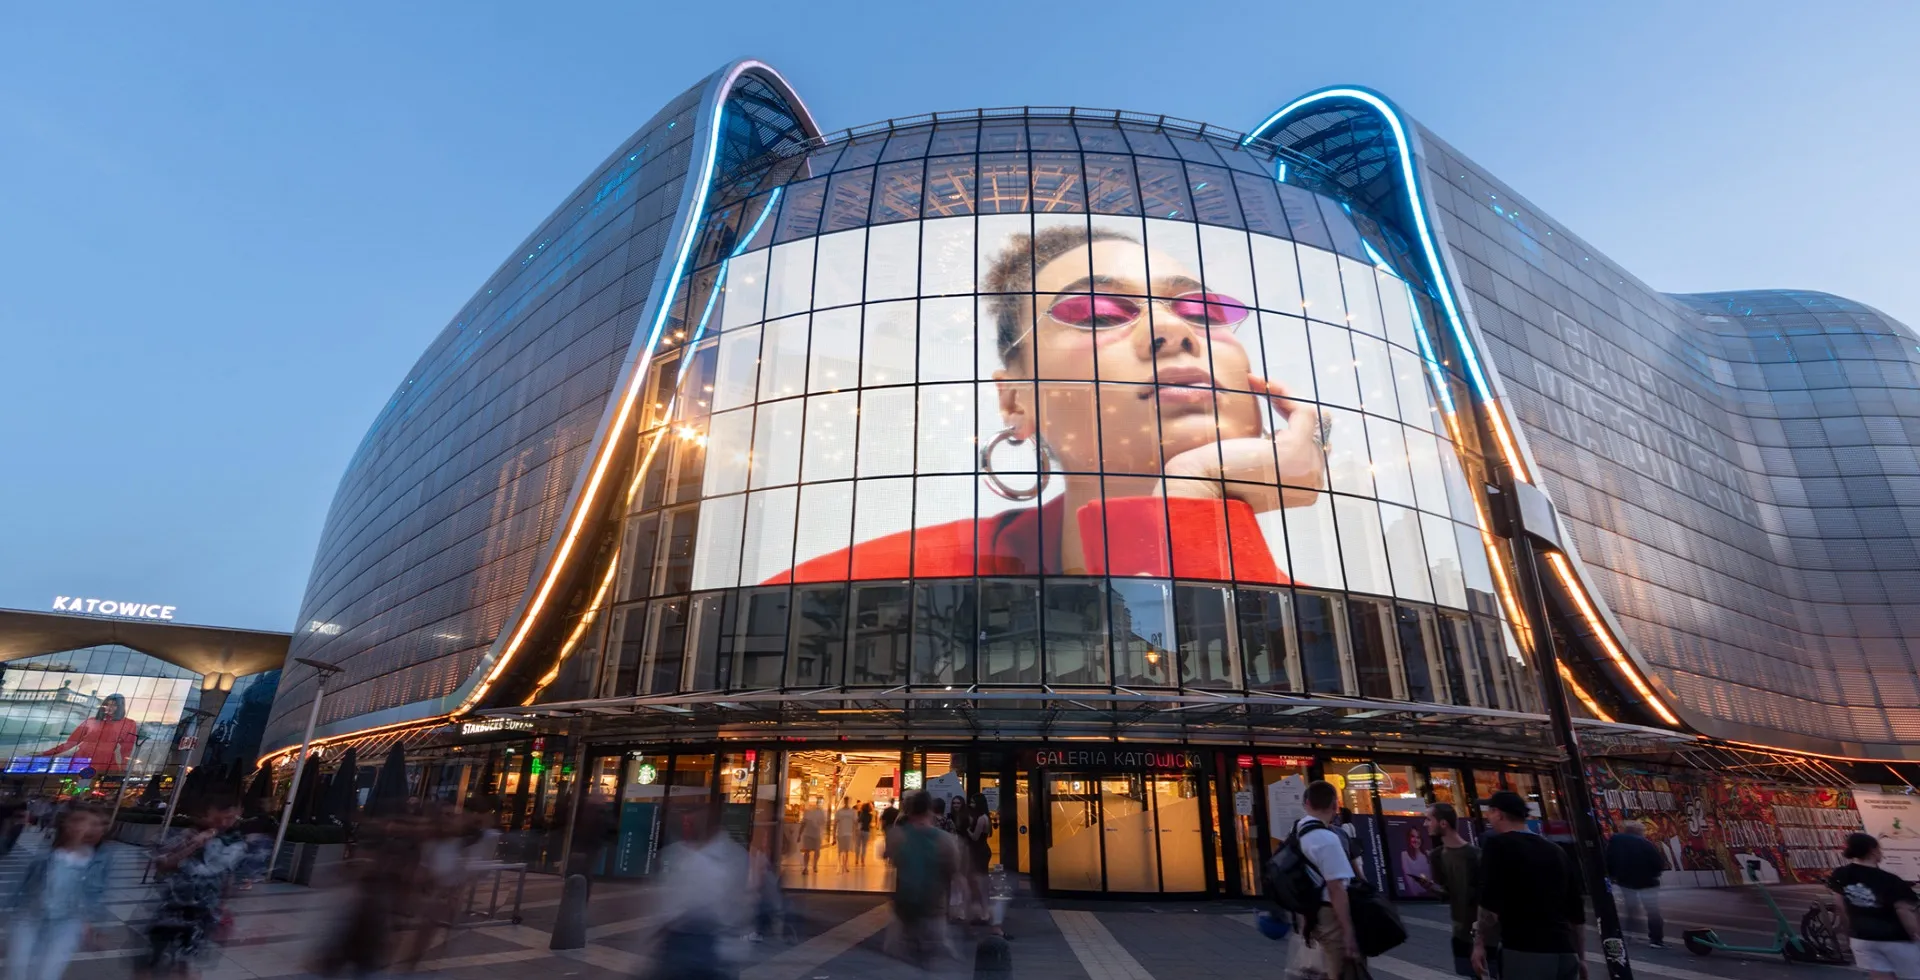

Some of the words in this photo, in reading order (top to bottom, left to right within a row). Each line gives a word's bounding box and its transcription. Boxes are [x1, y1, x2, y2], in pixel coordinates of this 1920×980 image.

[1553, 310, 1721, 454] GALERIA
[52, 595, 177, 620] KATOWICE
[1035, 751, 1107, 766] GALERIA
[1113, 752, 1202, 769] KATOWICKA
